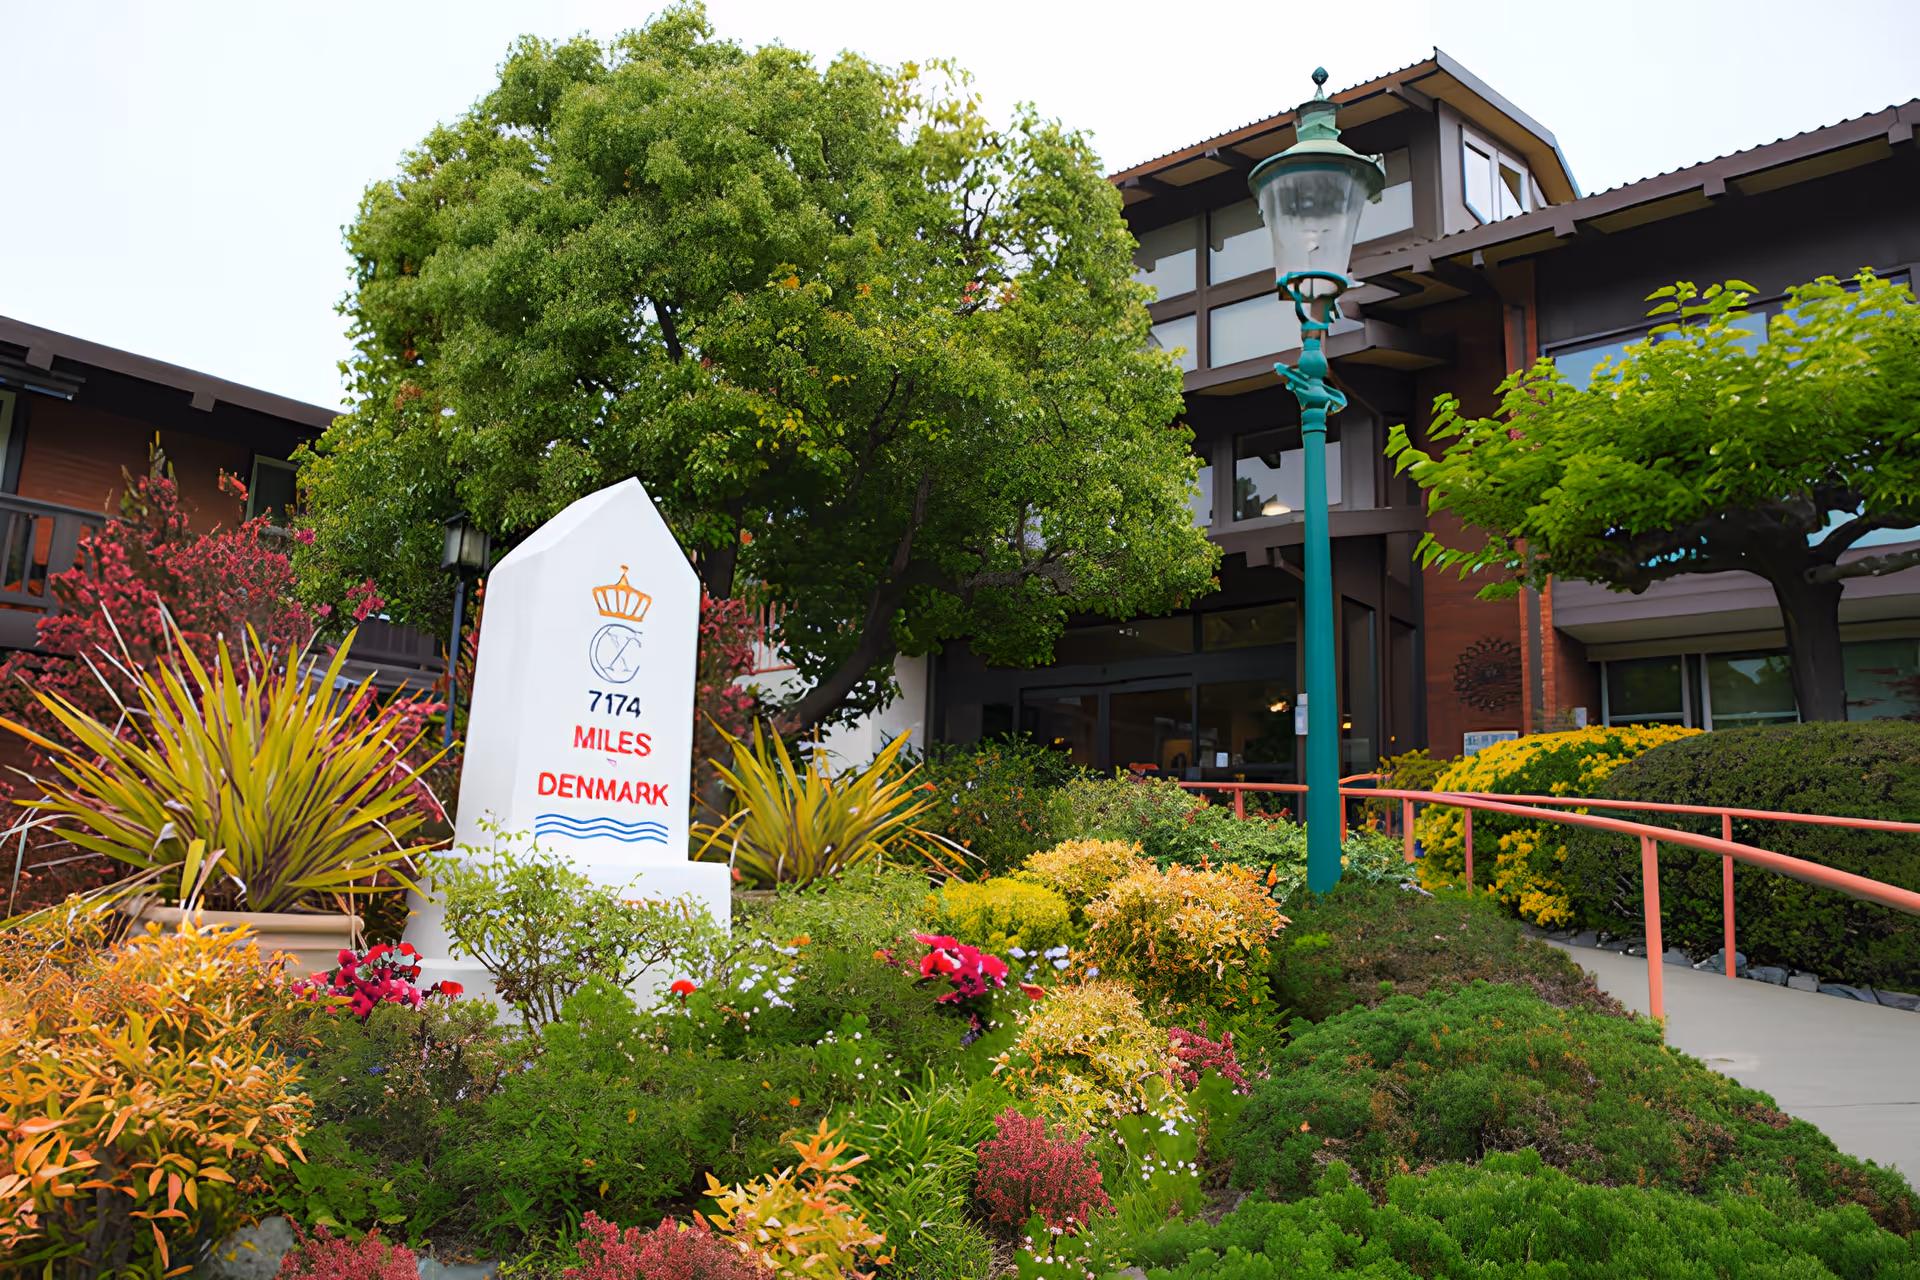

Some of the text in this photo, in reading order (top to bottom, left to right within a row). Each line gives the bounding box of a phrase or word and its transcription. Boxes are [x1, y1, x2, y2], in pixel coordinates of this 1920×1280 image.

[588, 690, 641, 718] 7174
[573, 725, 652, 757] MILES
[537, 772, 669, 807] DENMARK
